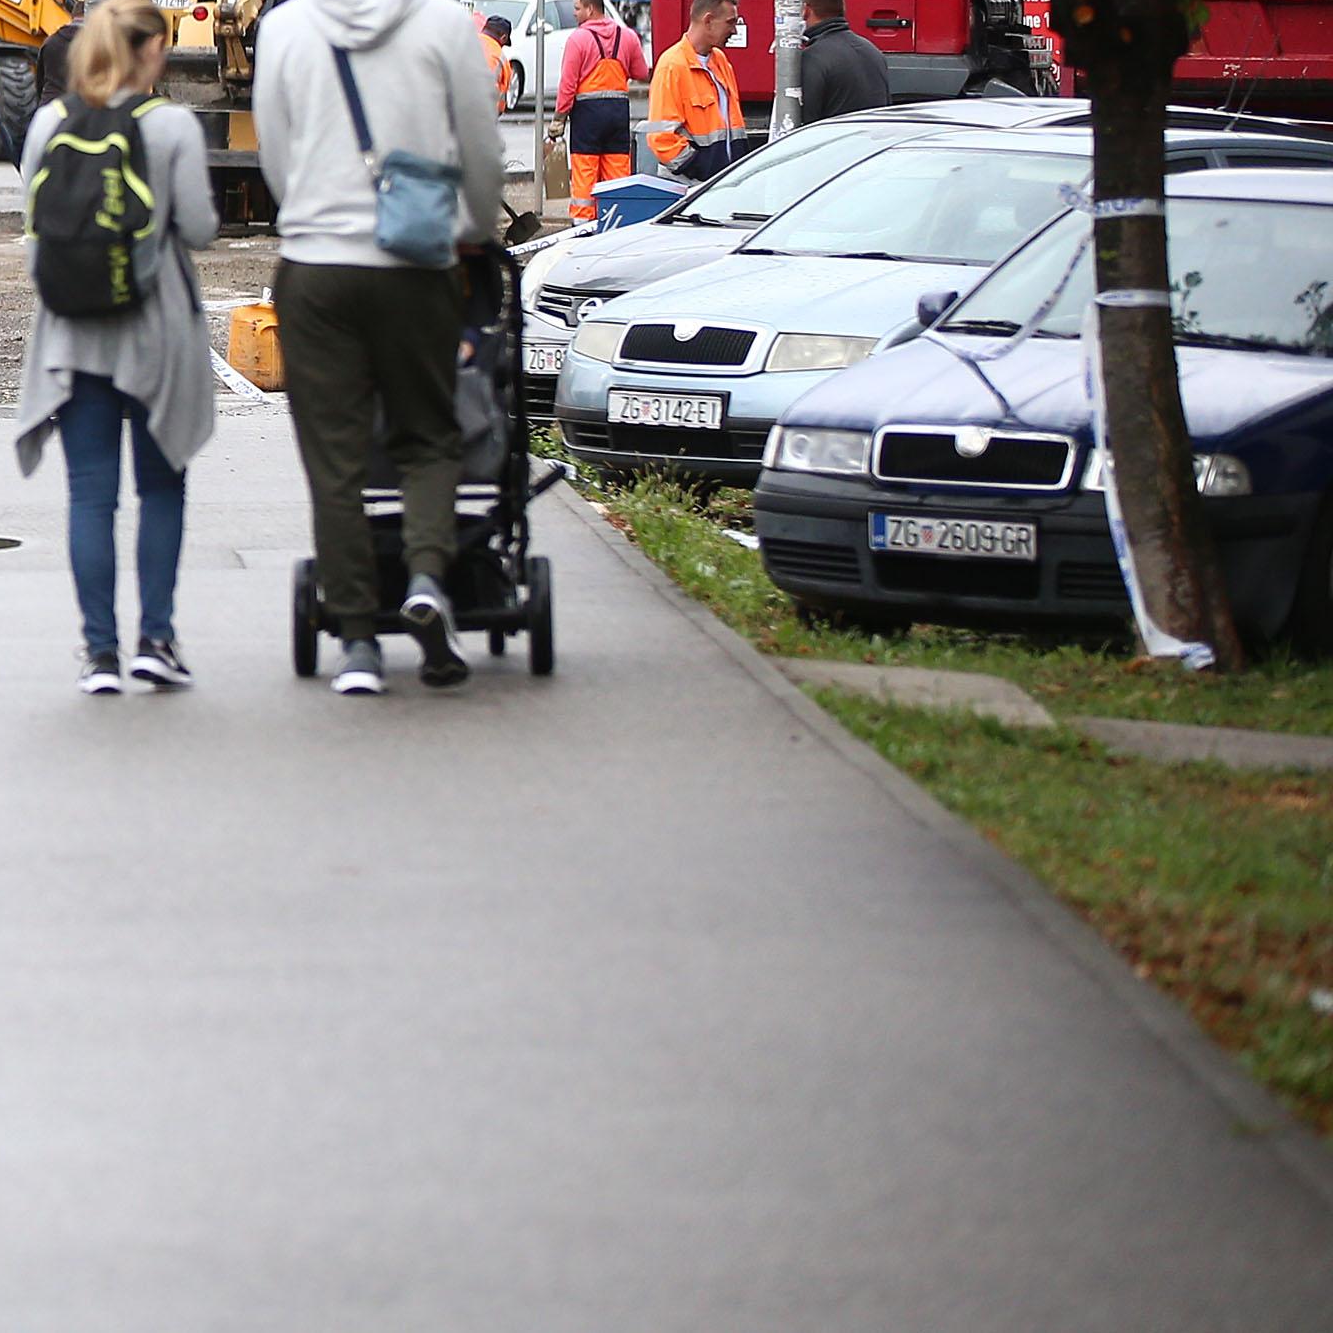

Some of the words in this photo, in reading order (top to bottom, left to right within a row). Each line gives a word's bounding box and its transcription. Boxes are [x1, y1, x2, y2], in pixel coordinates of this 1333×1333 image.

[529, 349, 546, 369] ZG
[621, 396, 640, 419] ZG
[889, 518, 919, 547] ZG
[937, 521, 1032, 554] 2609-GR
